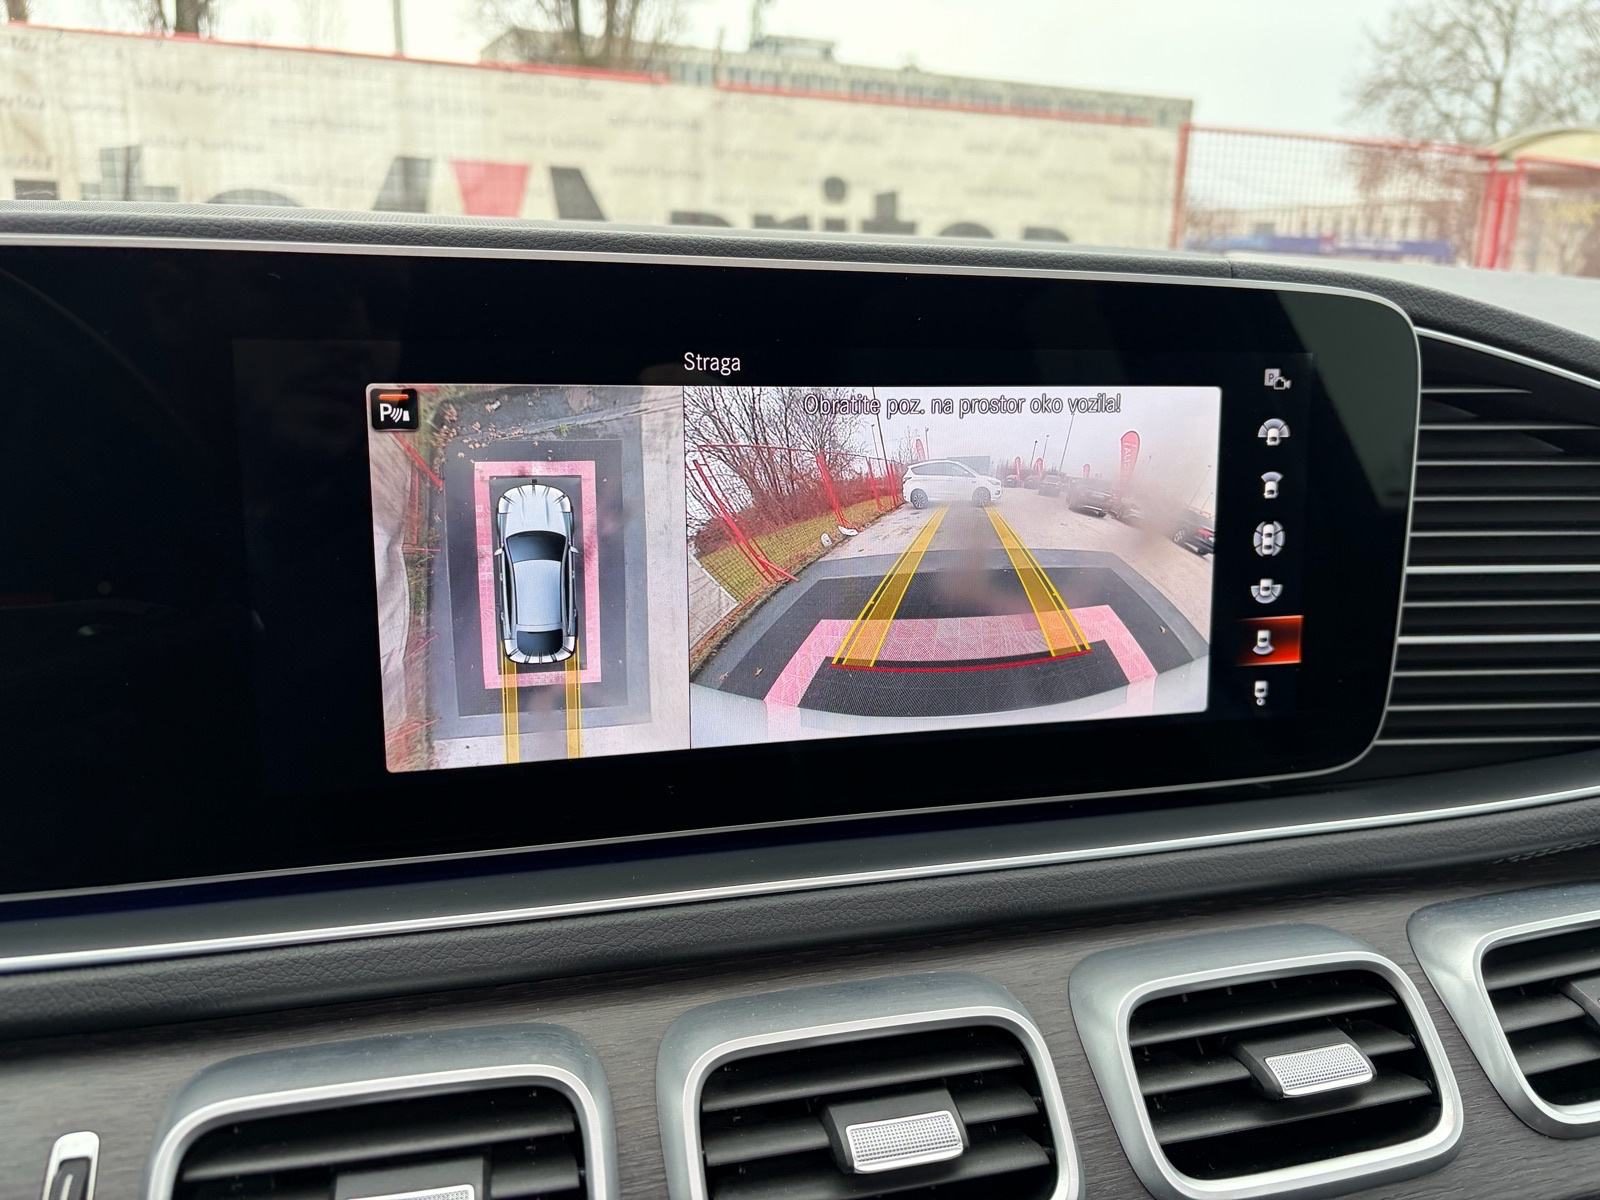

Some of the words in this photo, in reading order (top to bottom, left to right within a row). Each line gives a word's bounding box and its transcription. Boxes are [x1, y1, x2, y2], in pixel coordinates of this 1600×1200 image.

[684, 351, 741, 377] Straga
[804, 394, 881, 415] Obratite
[886, 399, 926, 420] poz.
[930, 397, 954, 415] na
[959, 395, 1025, 419] prostor
[1030, 393, 1064, 414] oko
[1067, 393, 1122, 414] vozila!
